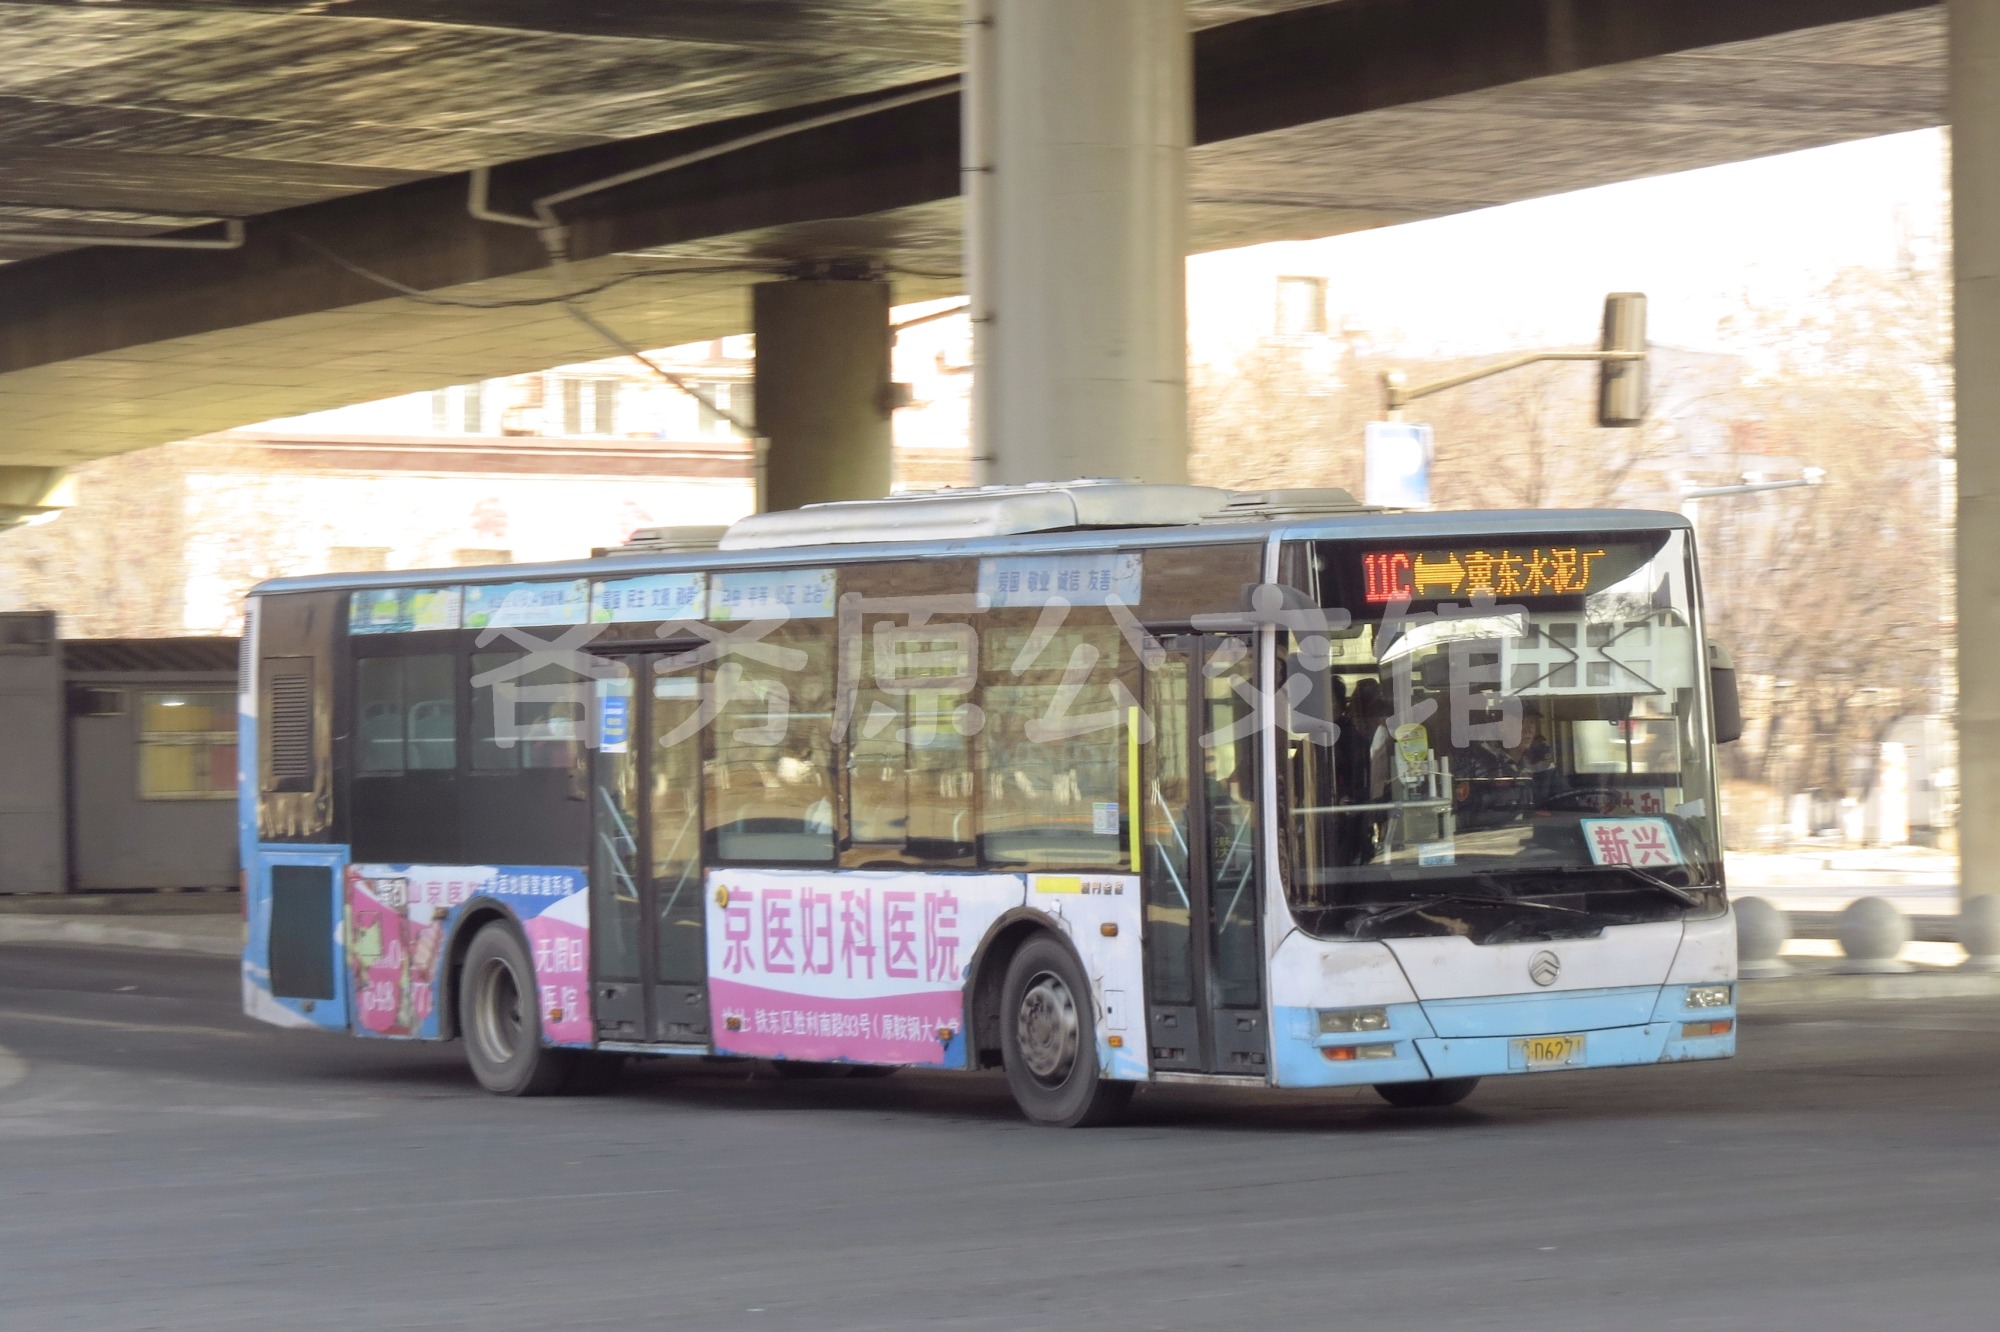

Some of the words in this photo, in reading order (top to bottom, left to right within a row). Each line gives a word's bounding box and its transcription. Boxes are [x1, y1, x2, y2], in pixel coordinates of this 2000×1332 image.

[1057, 570, 1080, 592] 诚信
[1088, 569, 1111, 591] 友善
[1365, 553, 1411, 601] 11C
[1464, 548, 1606, 597] 冀东水泥厂
[1594, 826, 1671, 866] 新兴
[722, 885, 960, 982] 京医妇科医院
